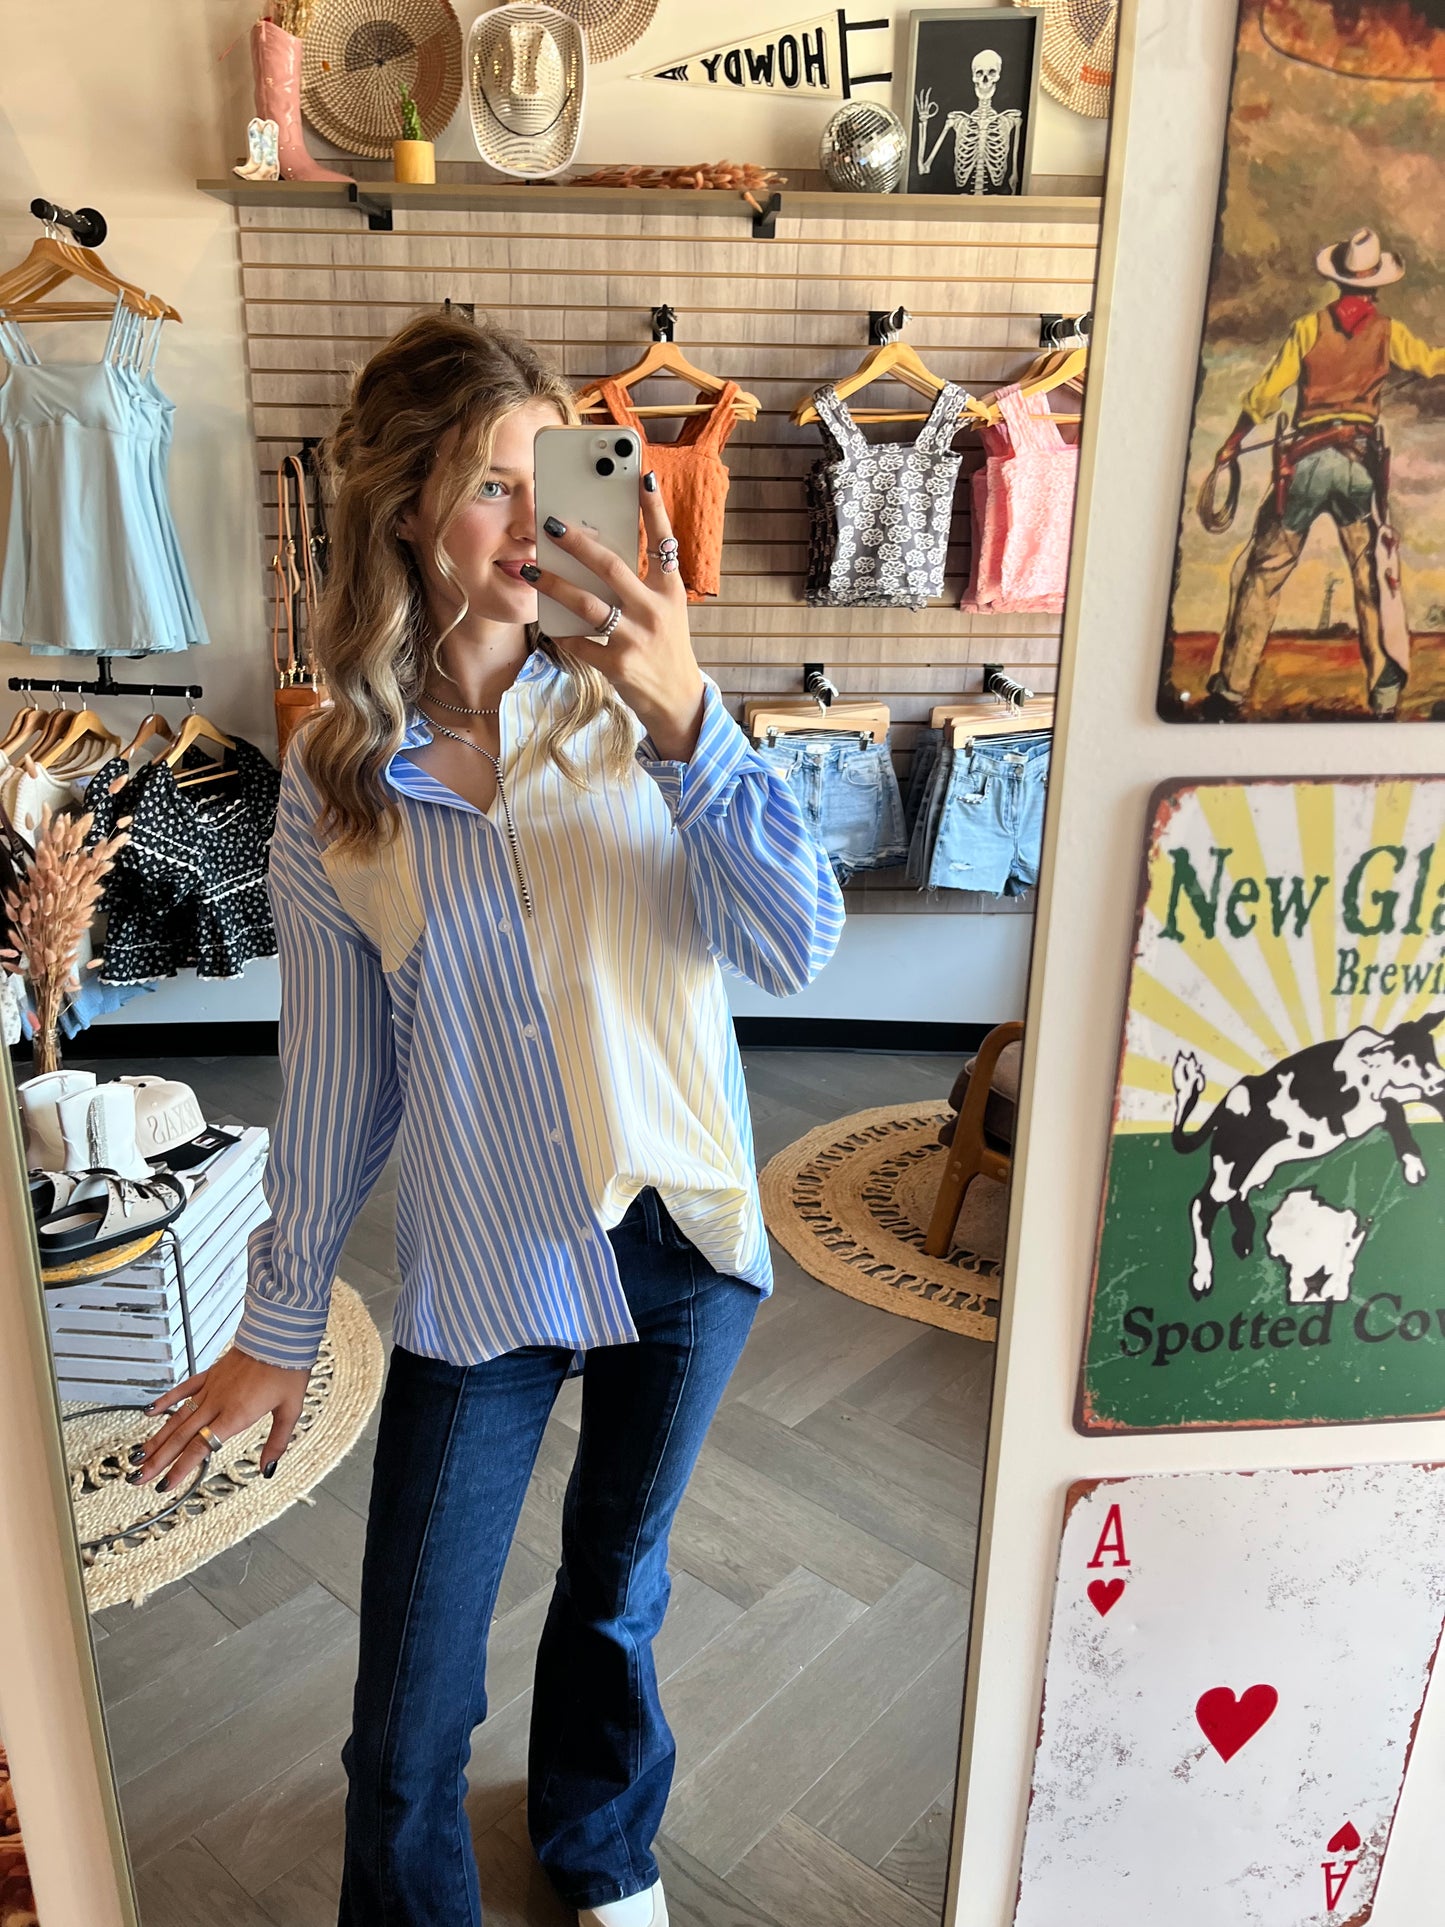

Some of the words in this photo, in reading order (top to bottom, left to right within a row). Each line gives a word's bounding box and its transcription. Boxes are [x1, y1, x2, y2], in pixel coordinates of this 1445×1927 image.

[1158, 846, 1330, 943] New
[1120, 1295, 1334, 1366] Spotted
[1086, 1504, 1131, 1568] A
[1321, 1860, 1357, 1911] A
